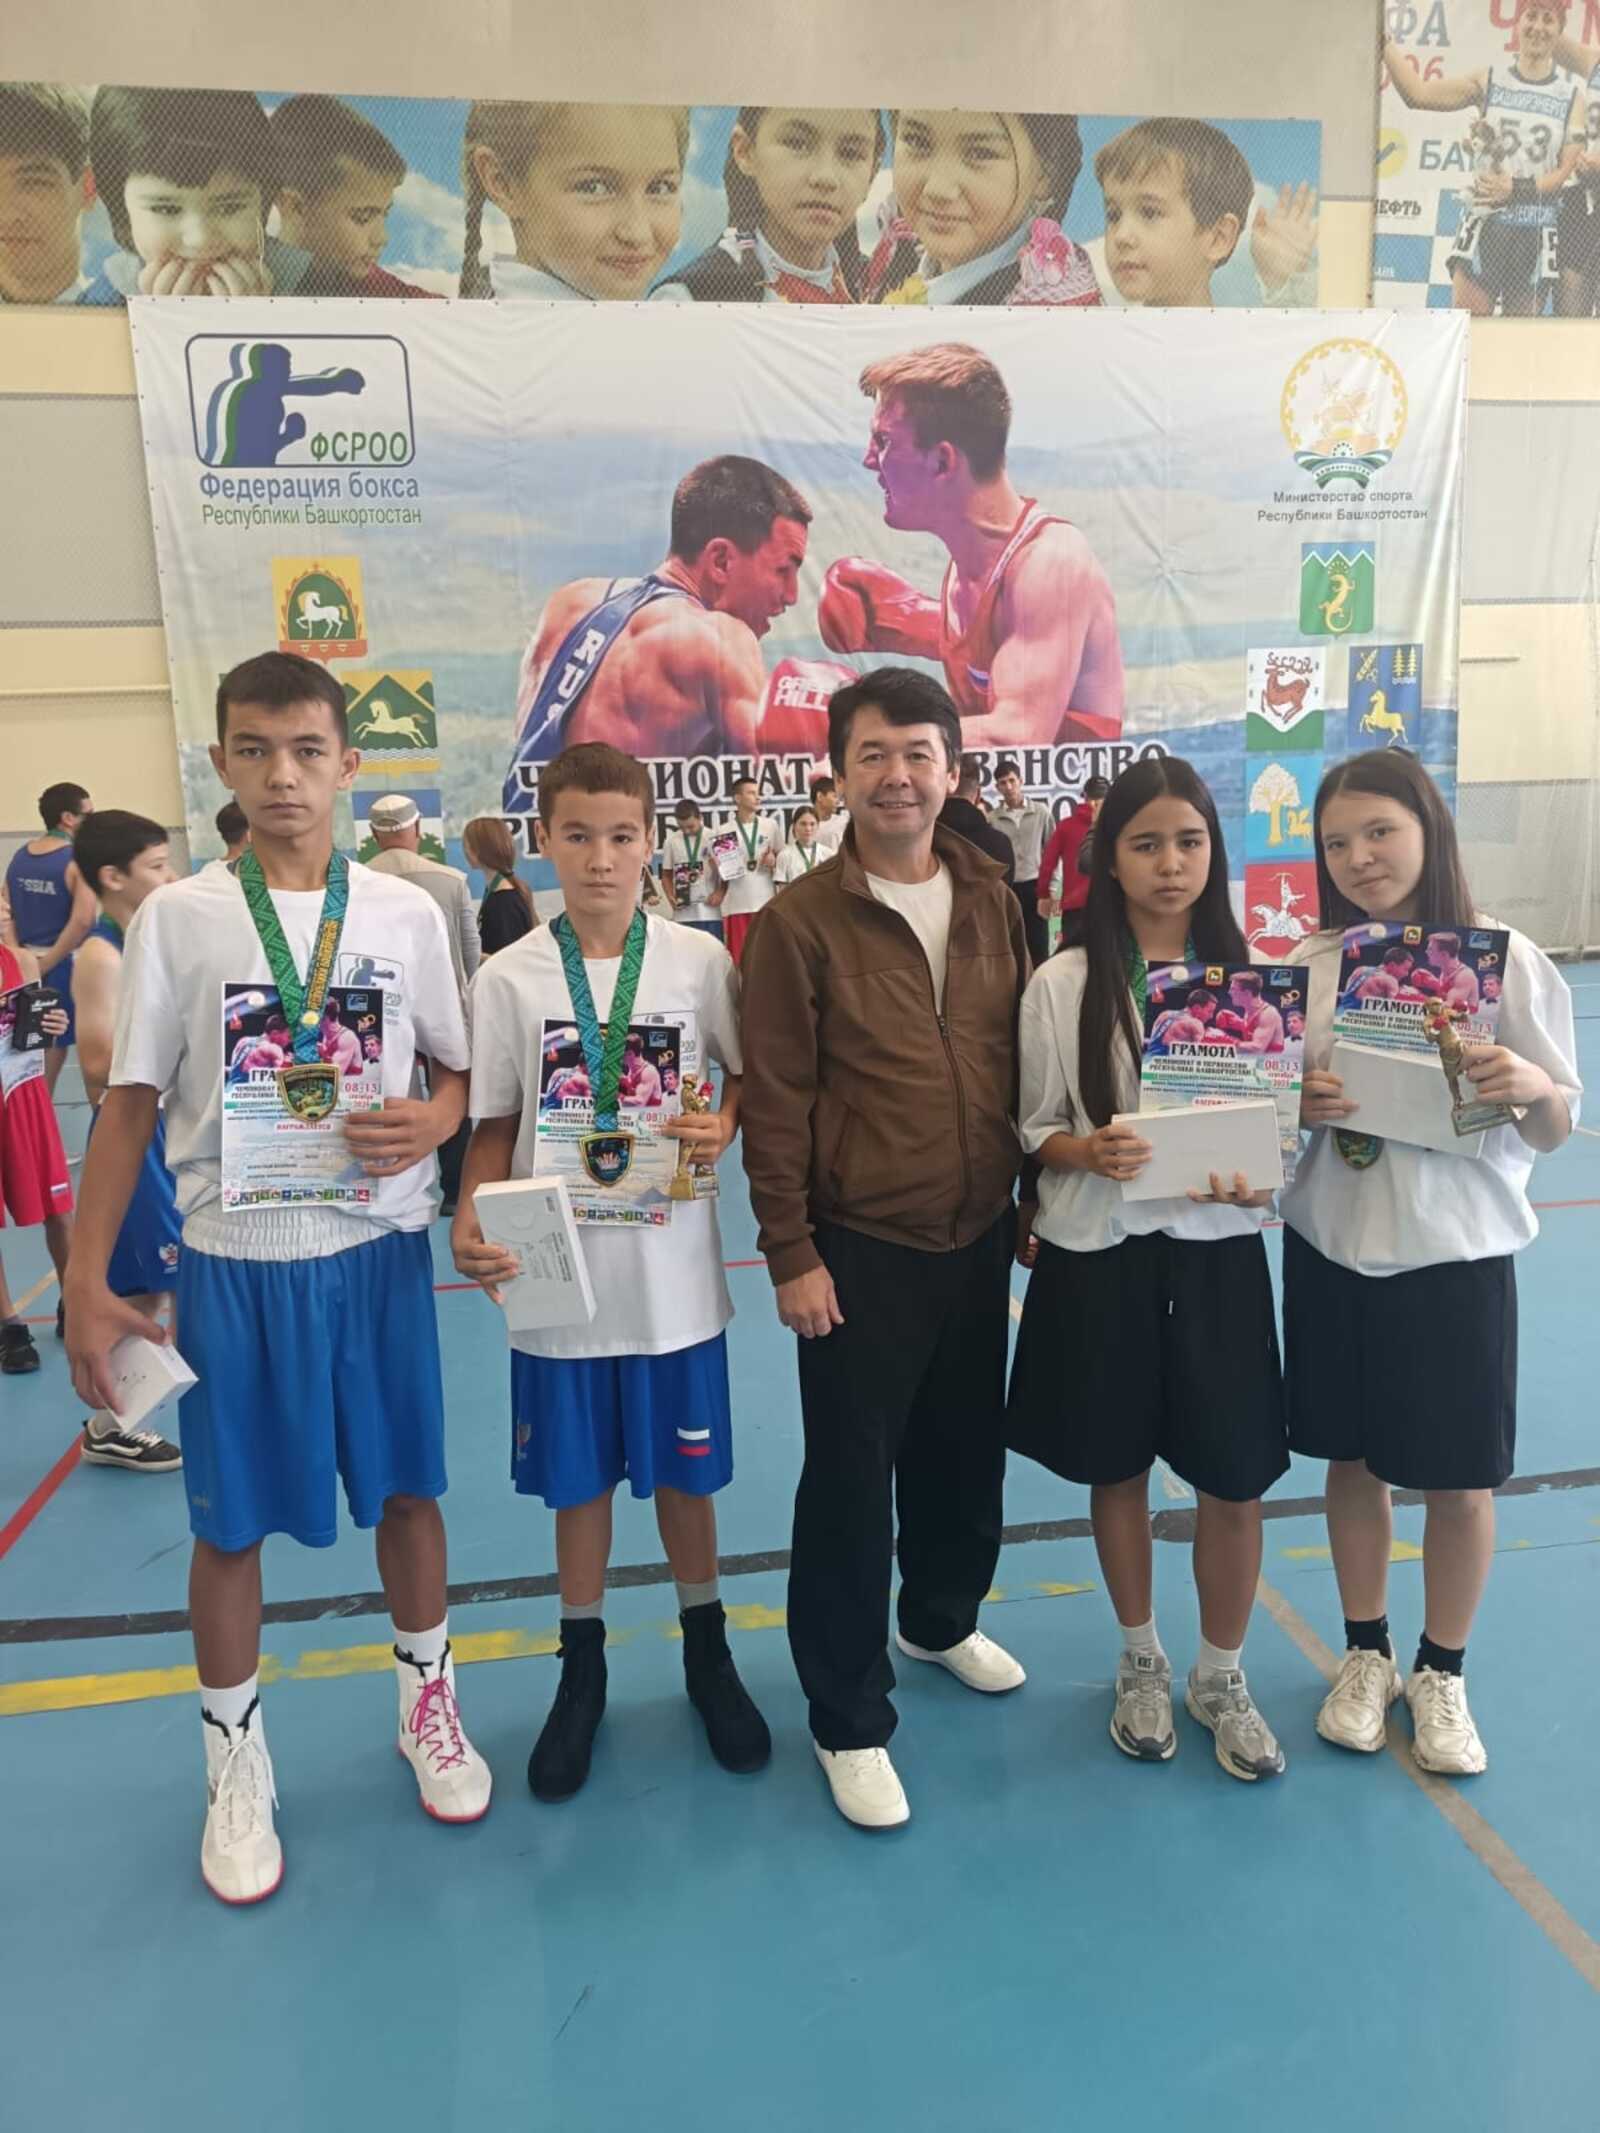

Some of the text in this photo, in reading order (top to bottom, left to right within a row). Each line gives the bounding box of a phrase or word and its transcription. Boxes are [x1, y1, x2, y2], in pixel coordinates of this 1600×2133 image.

[310, 432, 408, 462] ФСРОО
[200, 471, 419, 503] Федерация бокса
[1369, 491, 1413, 504] спорта
[202, 505, 422, 529] Республики Башкортостан
[1257, 508, 1428, 524] Республики Башкортостан
[1171, 1043, 1236, 1058] ГРАМОТА
